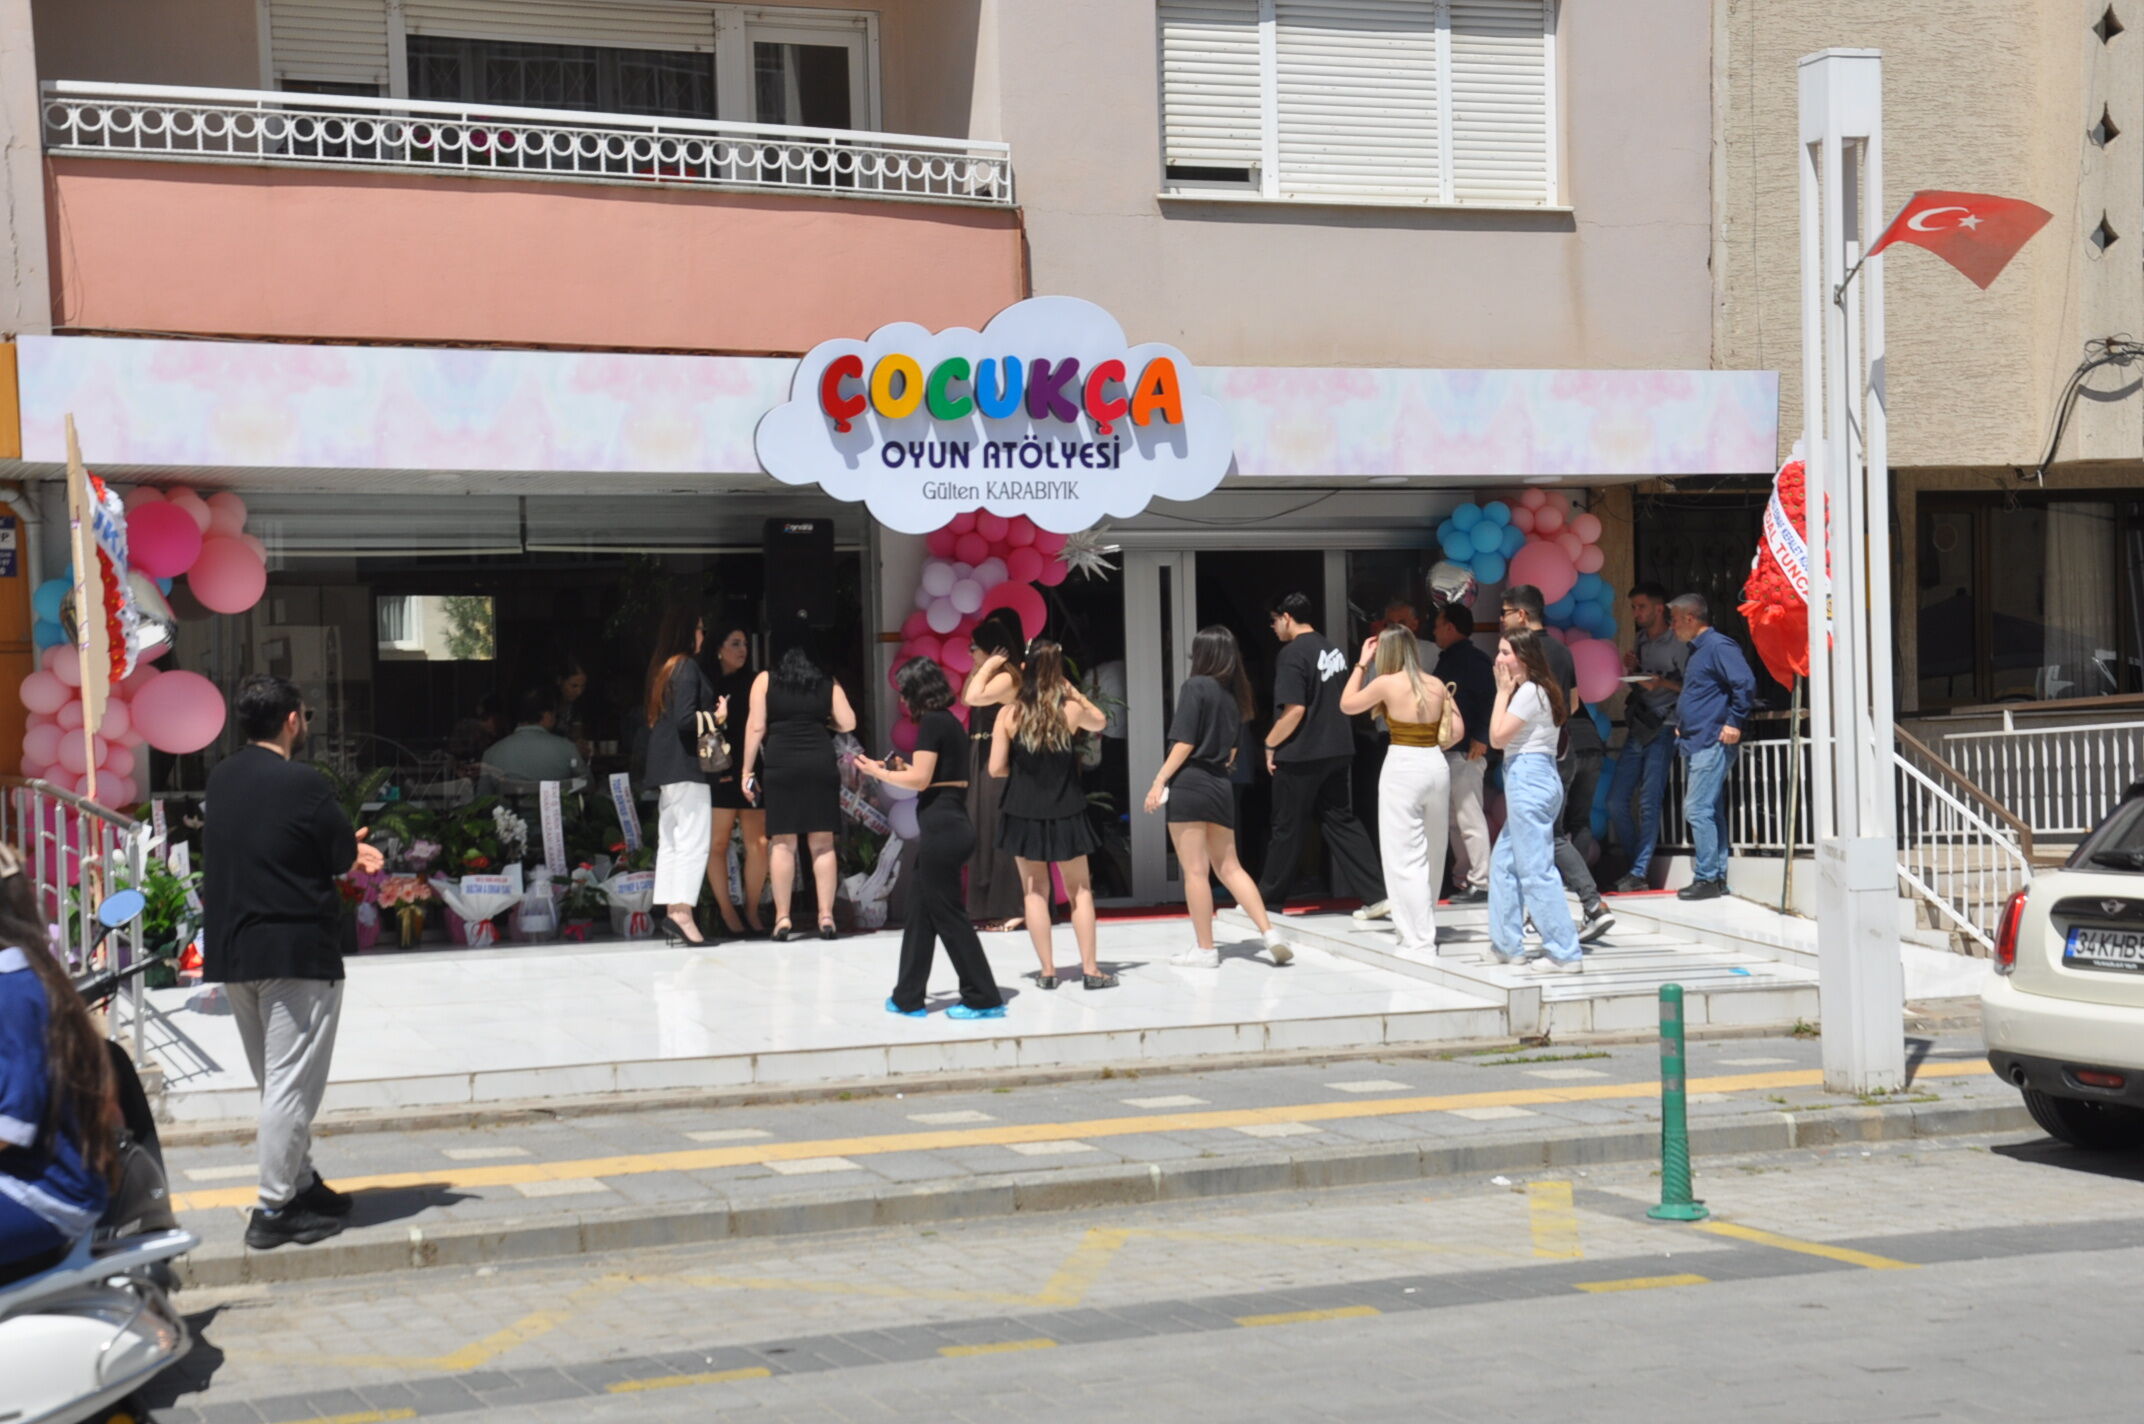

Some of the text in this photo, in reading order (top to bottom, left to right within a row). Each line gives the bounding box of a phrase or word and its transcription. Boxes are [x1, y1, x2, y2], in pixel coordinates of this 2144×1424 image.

[820, 353, 1184, 435] ÇOCUKÇA
[881, 434, 1120, 469] OYUN ATÖLYESİ
[922, 480, 1080, 500] Gülten KARABIYIK
